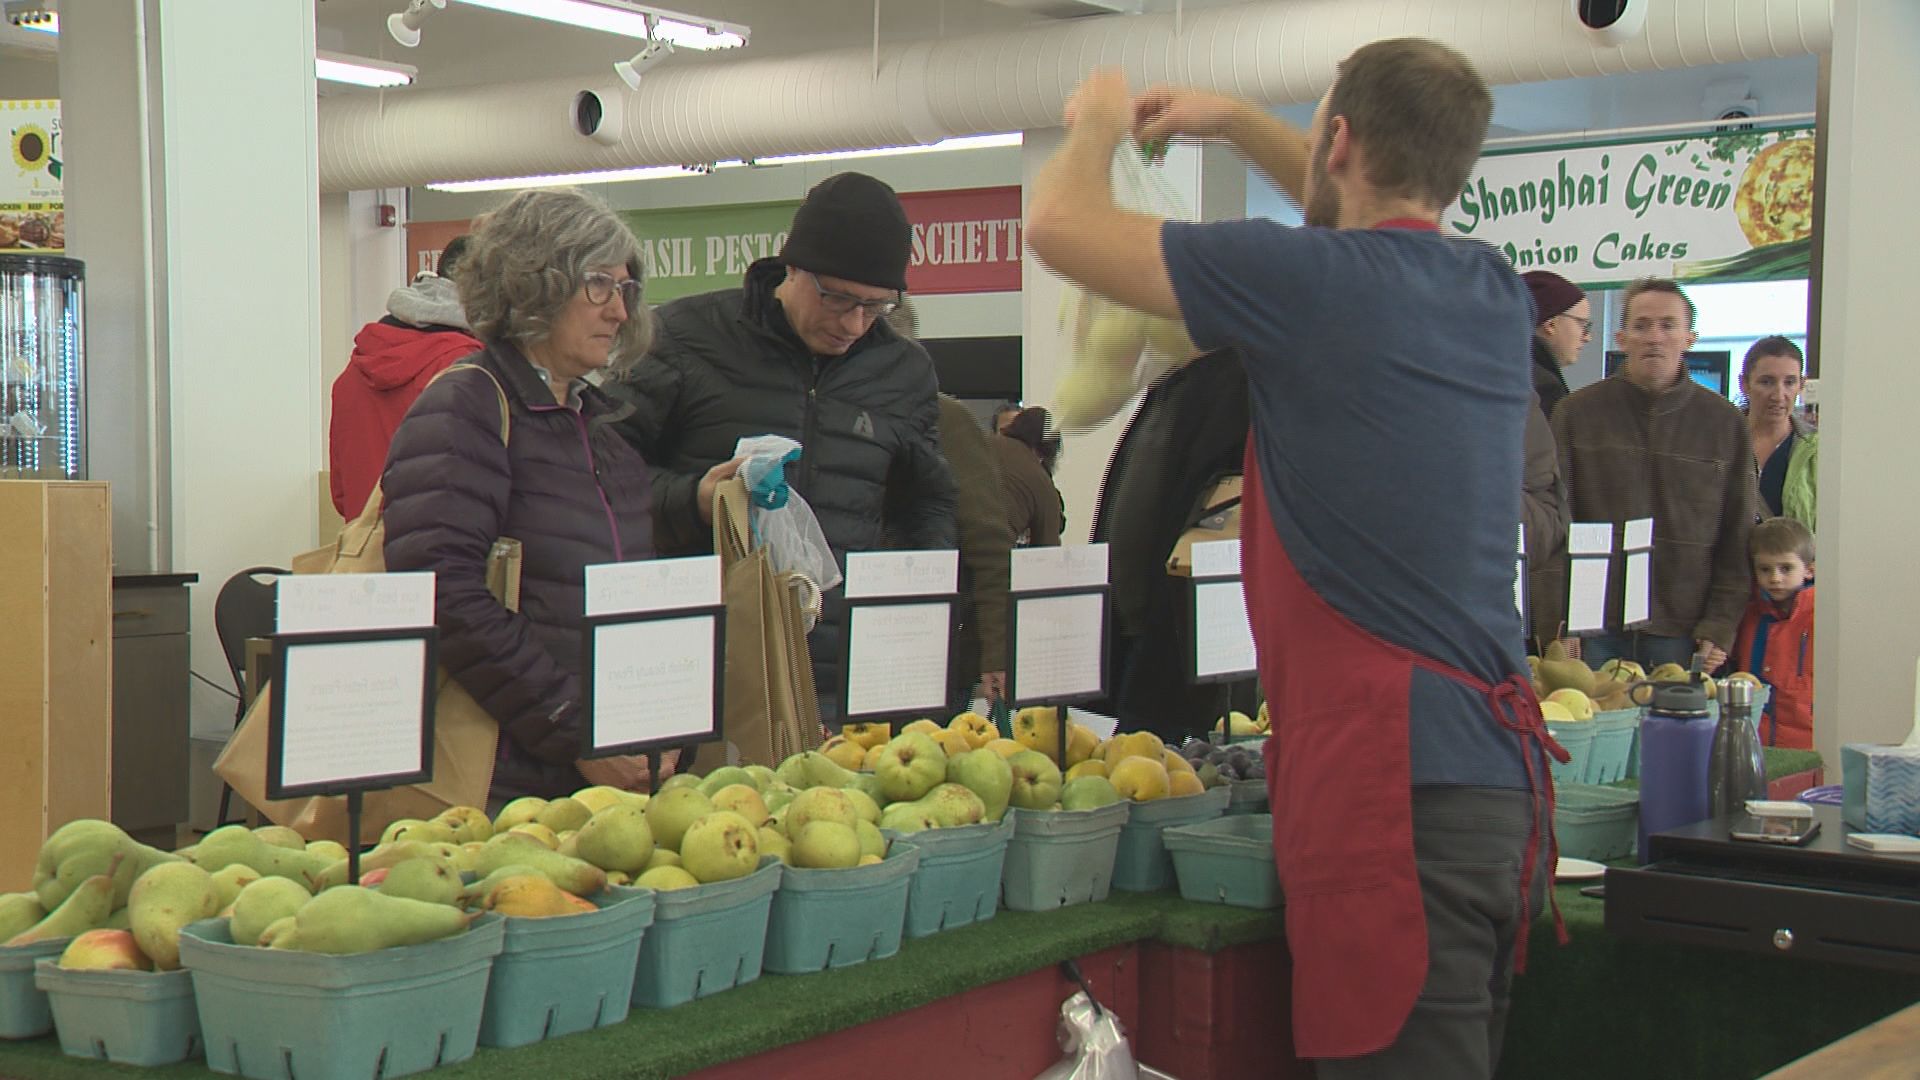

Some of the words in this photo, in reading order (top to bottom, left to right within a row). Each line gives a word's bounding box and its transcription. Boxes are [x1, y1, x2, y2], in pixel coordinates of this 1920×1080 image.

[1451, 154, 1610, 234] Shanghai
[1625, 153, 1733, 218] Green
[1592, 232, 1688, 270] Cakes
